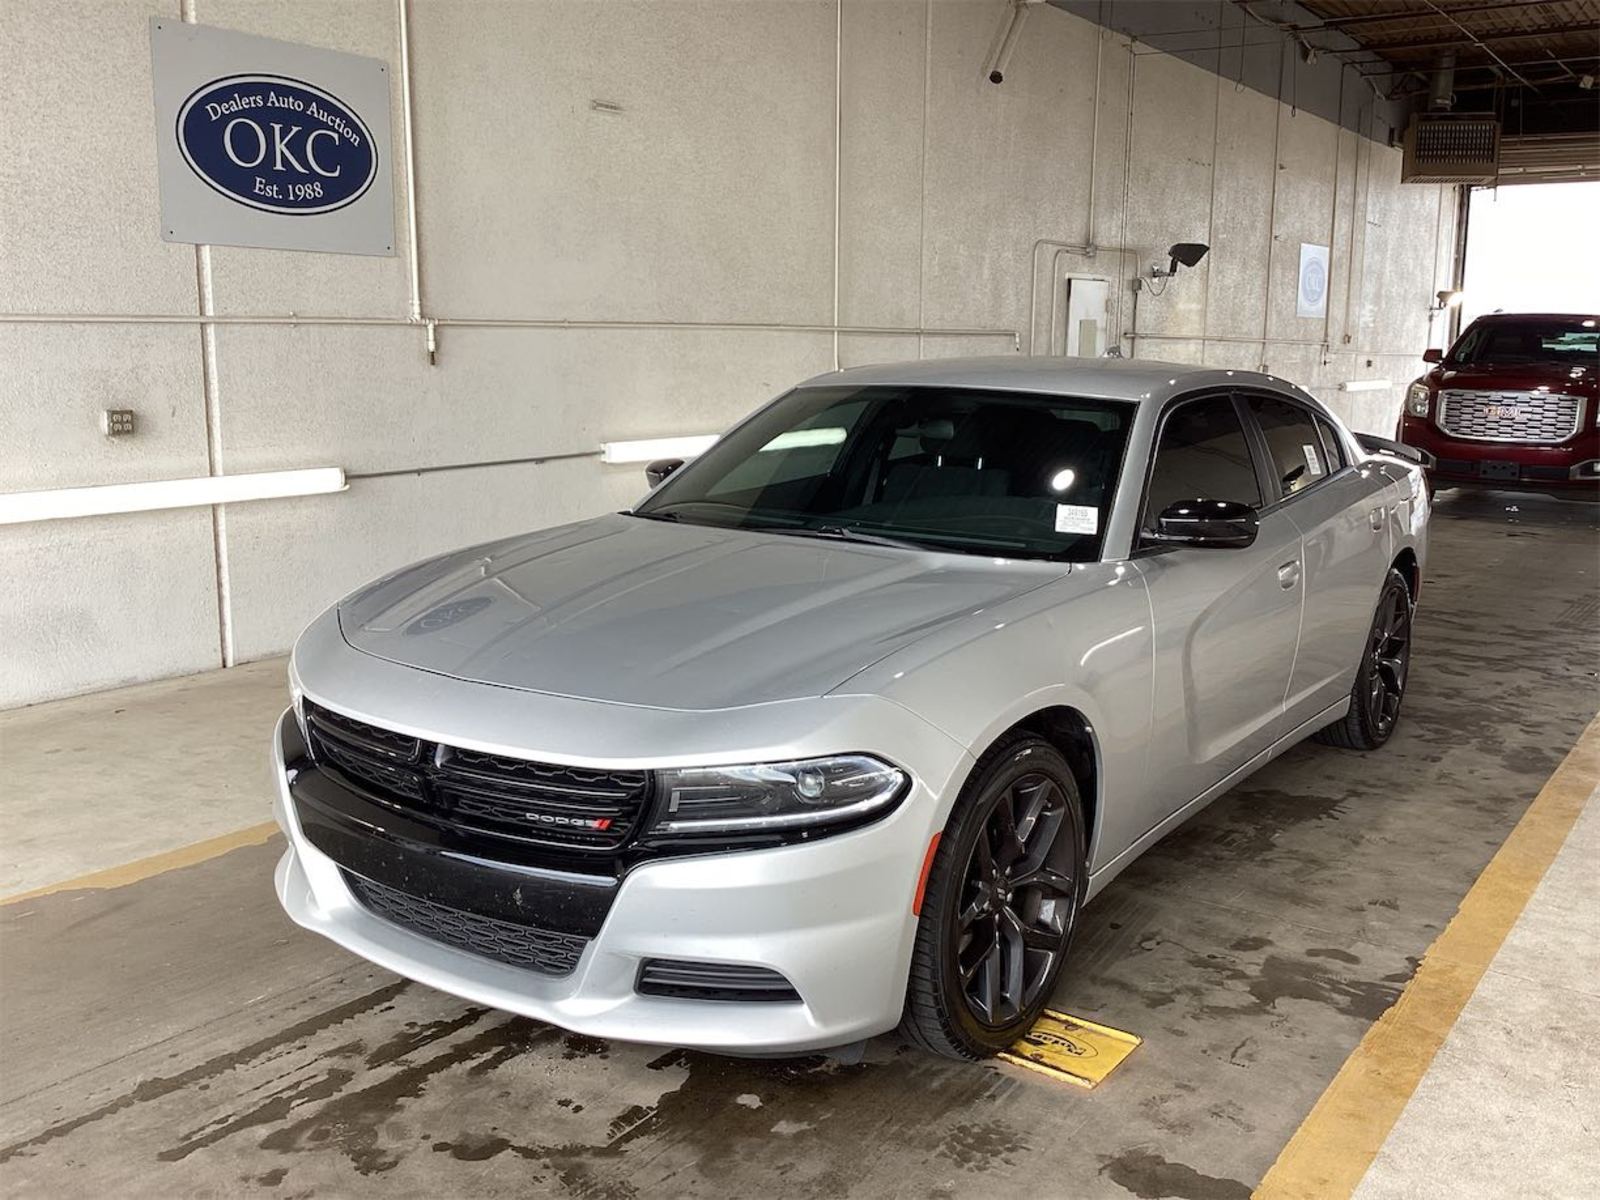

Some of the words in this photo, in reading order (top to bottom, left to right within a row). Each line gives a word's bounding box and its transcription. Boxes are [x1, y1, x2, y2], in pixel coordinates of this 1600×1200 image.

[205, 93, 264, 121] Dealers
[267, 91, 303, 111] Auto
[306, 101, 360, 147] Auction
[223, 118, 341, 178] OKC
[253, 176, 282, 200] Est.
[288, 181, 323, 201] 1988
[525, 813, 594, 828] DODGE
